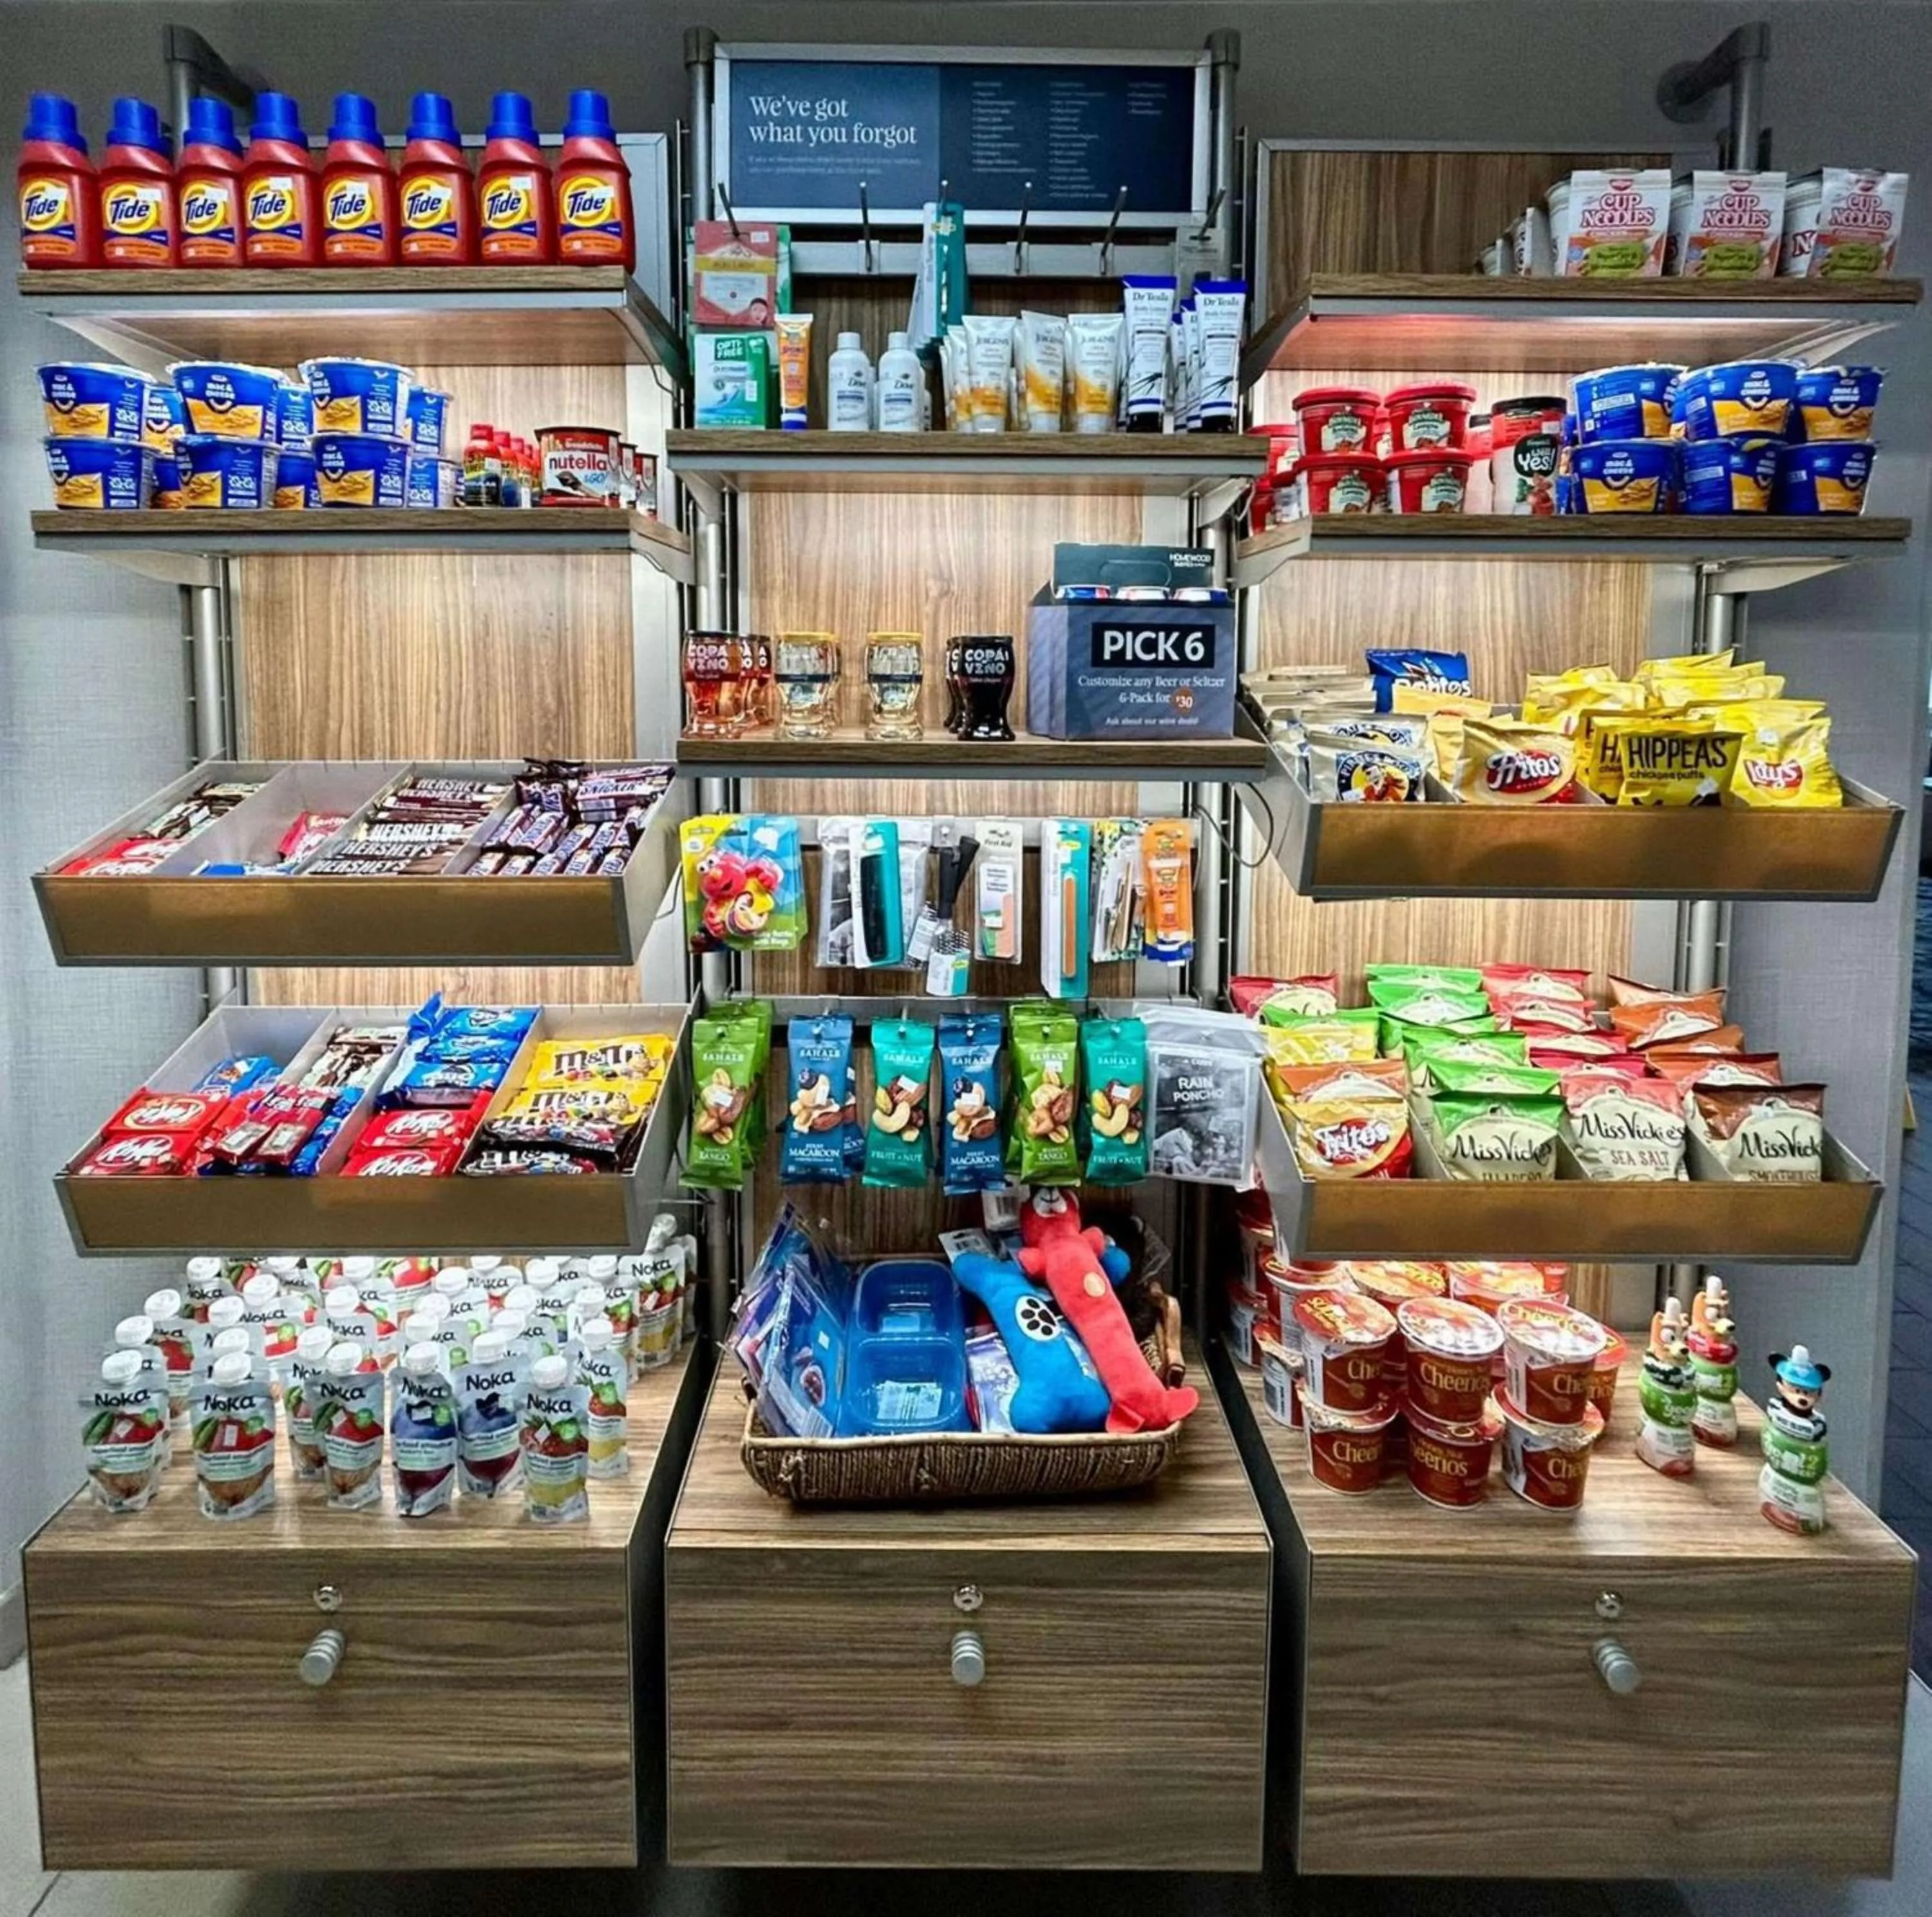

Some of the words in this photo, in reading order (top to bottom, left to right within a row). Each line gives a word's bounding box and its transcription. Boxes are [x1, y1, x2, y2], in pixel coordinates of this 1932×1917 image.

[750, 95, 811, 117] We've
[814, 98, 849, 122] got
[749, 121, 804, 144] what
[808, 126, 848, 148] you
[853, 122, 918, 149] forgot
[25, 195, 59, 221] Tide
[109, 198, 151, 225] Tide
[185, 197, 218, 224] Tide
[251, 193, 287, 221] Tide
[330, 193, 366, 221] Tide
[407, 193, 442, 221] Tide
[488, 192, 522, 221] Tide
[568, 191, 607, 218] Tide
[1598, 193, 1642, 211] CUP
[1719, 193, 1759, 211] CUP
[1845, 194, 1881, 212] CUP
[1580, 207, 1656, 228] NOODLES
[1701, 209, 1772, 229] NOODLES
[1827, 209, 1893, 229] NOODLES
[1133, 292, 1146, 301] Dr
[1203, 298, 1216, 306] Dr
[549, 453, 608, 470] nutella
[1517, 448, 1557, 472] Yes!
[687, 645, 728, 657] COPA
[965, 649, 1005, 661] COPA
[1103, 630, 1180, 661] PICK
[1184, 631, 1205, 662] 6
[687, 657, 729, 671] VINO
[966, 662, 1006, 674] VINO
[1078, 676, 1132, 687] Customize
[1133, 678, 1153, 689] any
[1155, 676, 1177, 687] Beer
[1179, 678, 1191, 687] or
[1192, 676, 1226, 688] Seltzer
[1119, 692, 1153, 703] 6-Pack
[1155, 692, 1171, 703] for
[1628, 737, 1728, 769] HIPPEAS
[1486, 748, 1560, 791] Fritos
[1746, 759, 1801, 788] Lay's
[580, 781, 642, 796] SNICKER
[341, 841, 438, 857] HERSHEY'S
[309, 859, 412, 873] HERSHEY'S
[1178, 1077, 1214, 1090] RAIN
[1173, 1089, 1226, 1103] PONCHO
[1314, 1120, 1391, 1159] Fritos
[1580, 1112, 1626, 1139] Miss
[1615, 1111, 1687, 1148] Vickie's
[1452, 1134, 1501, 1161] Miss
[1739, 1132, 1786, 1158] Miss
[1779, 1125, 1823, 1158] Vick
[789, 1147, 841, 1158] MACAROON
[903, 1153, 923, 1162] NUT
[950, 1156, 1000, 1166] MACAROON
[1611, 1150, 1636, 1165] SEA
[1640, 1150, 1671, 1166] SALT
[632, 1258, 672, 1277] Noka
[292, 1363, 323, 1380] Nok
[466, 1370, 516, 1391] Noka
[94, 1389, 151, 1407] Noka
[203, 1394, 256, 1413] Noka
[526, 1393, 573, 1414] Noka
[1333, 1442, 1381, 1464] Cheer
[1408, 1440, 1469, 1477] heerios
